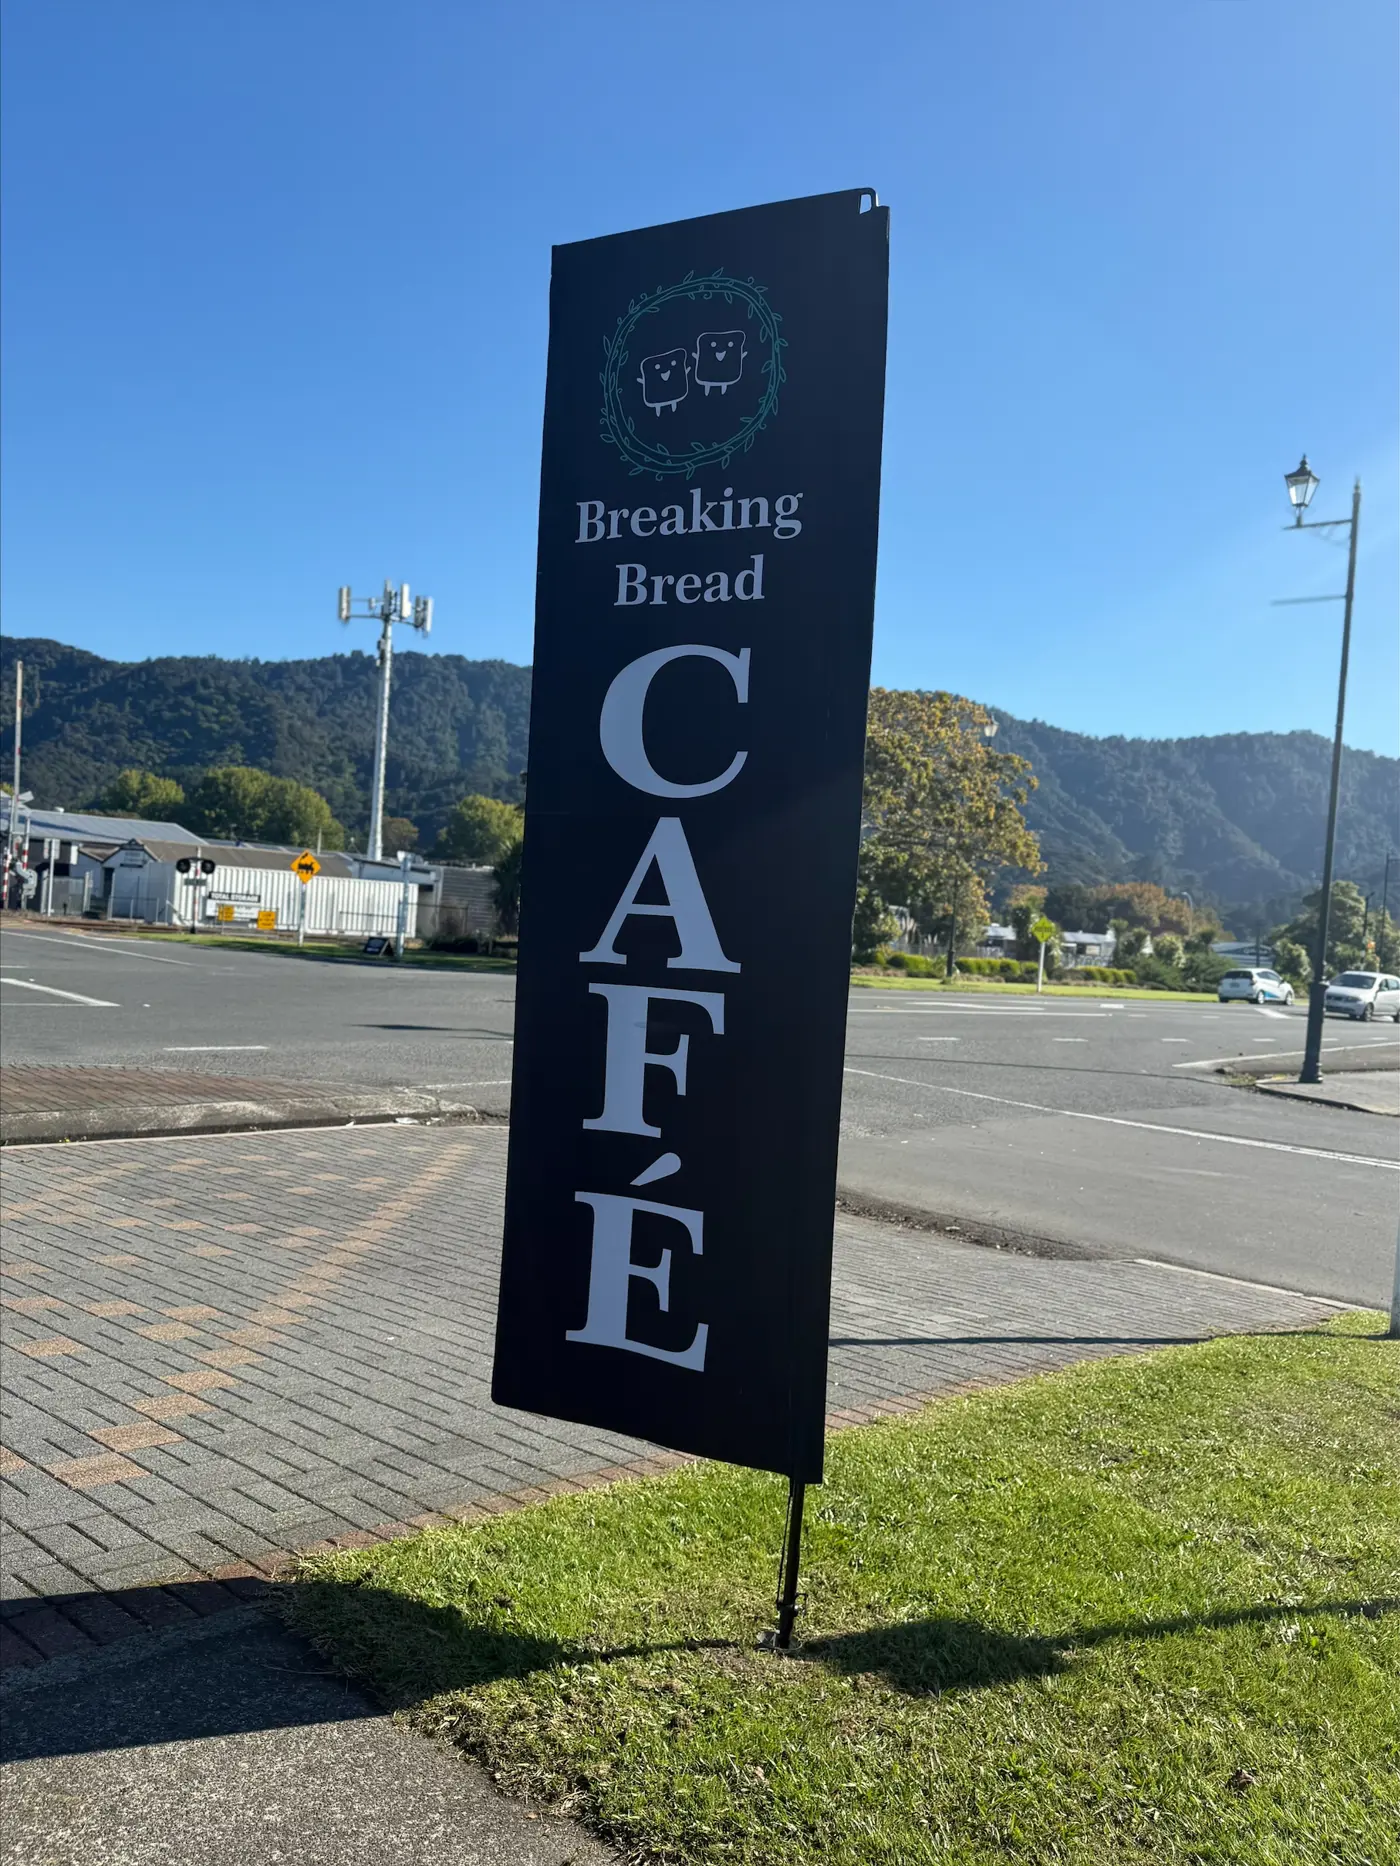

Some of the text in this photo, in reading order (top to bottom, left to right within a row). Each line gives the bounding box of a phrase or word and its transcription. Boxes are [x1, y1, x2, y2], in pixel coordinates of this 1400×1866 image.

[575, 487, 804, 543] Breaking
[613, 553, 766, 606] Bread
[565, 644, 751, 1372] CAFÉ
